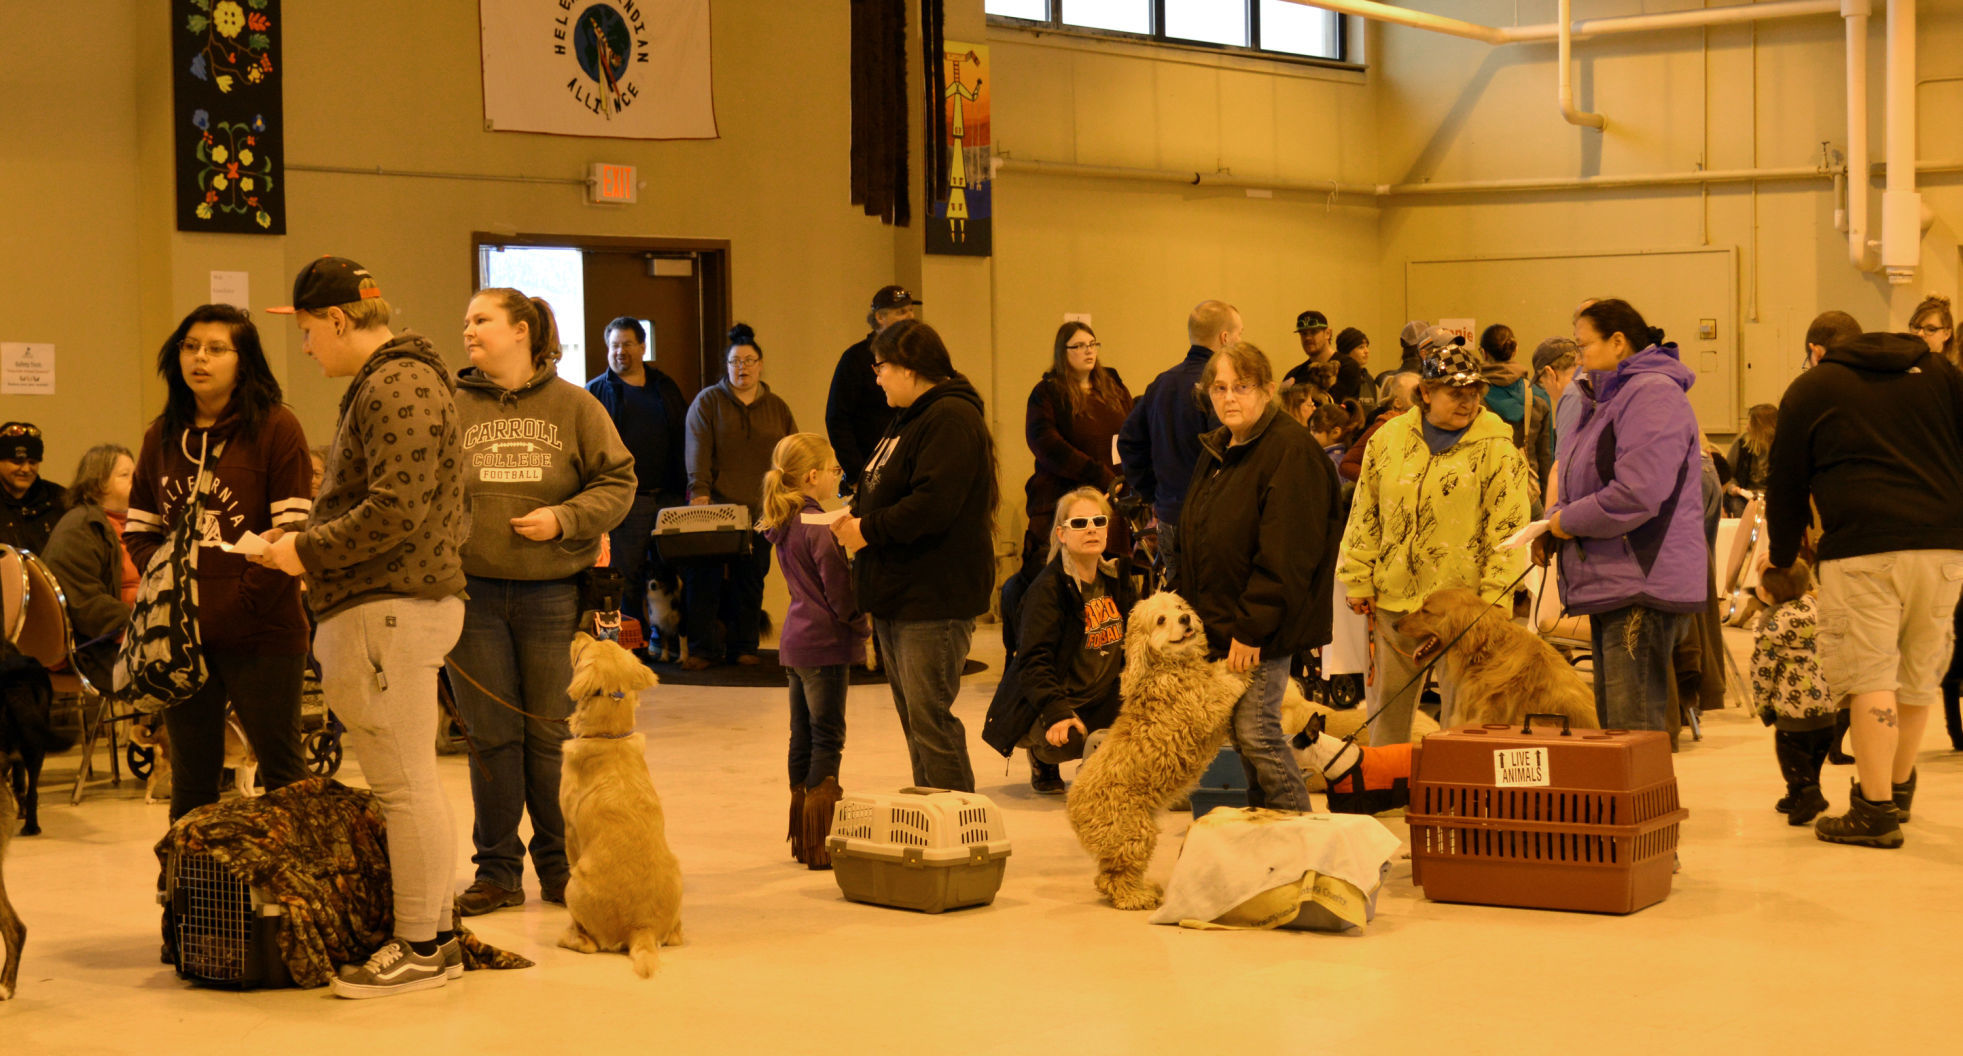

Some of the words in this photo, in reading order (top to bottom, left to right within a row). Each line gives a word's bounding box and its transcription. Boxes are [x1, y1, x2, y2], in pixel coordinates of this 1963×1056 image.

[618, 0, 649, 63] NDIAN
[567, 77, 639, 114] ALLINCE
[603, 165, 631, 199] EXIT
[463, 418, 562, 451] CARROLL
[472, 452, 552, 468] COLLEGE
[482, 470, 540, 480] FOOTBALL
[162, 475, 245, 528] CALIFRNIA
[1503, 766, 1542, 783] ANIMALS
[1511, 751, 1530, 767] LIVE
